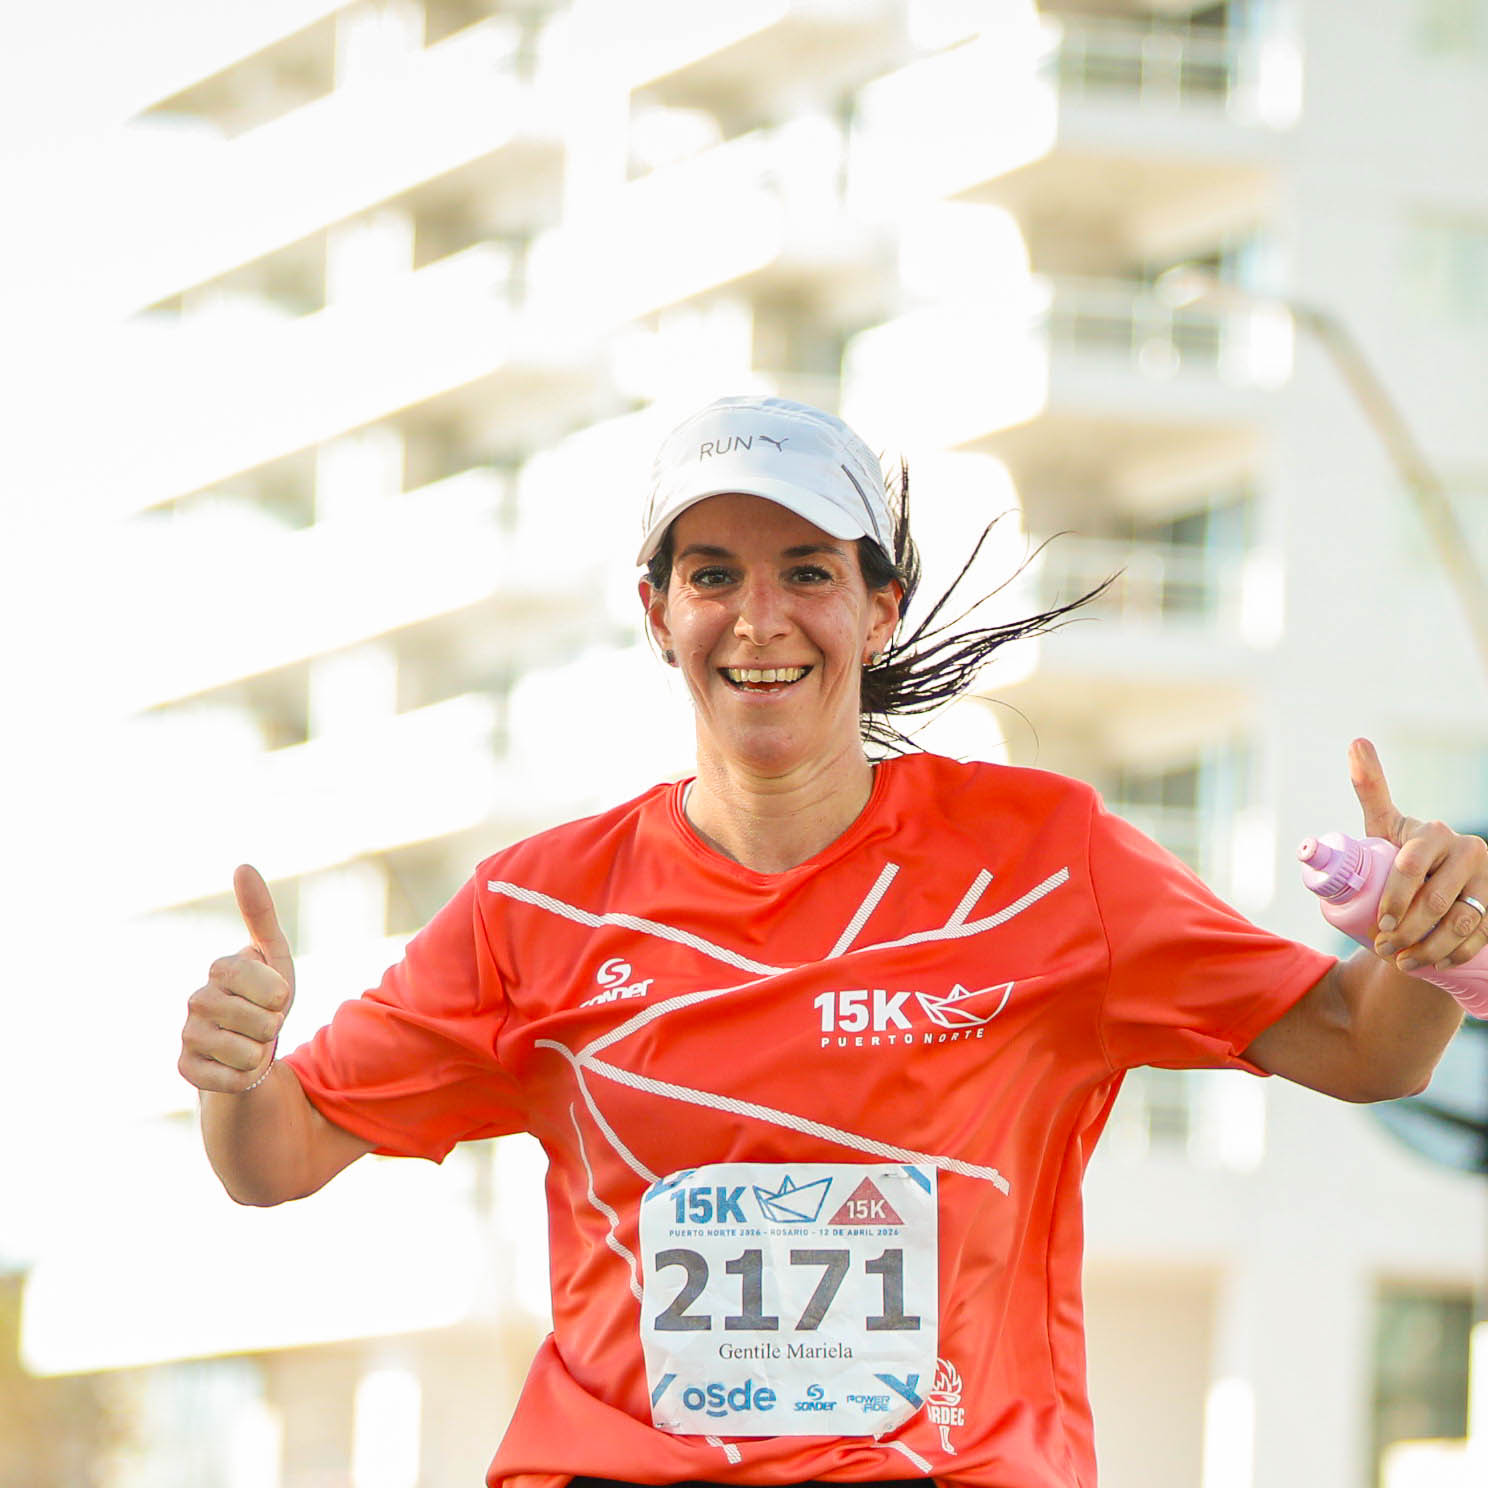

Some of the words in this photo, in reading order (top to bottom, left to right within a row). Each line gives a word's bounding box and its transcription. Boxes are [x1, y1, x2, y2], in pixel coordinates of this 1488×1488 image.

[699, 435, 753, 462] RUN
[813, 990, 913, 1033] 15K
[821, 1034, 914, 1048] PUERTO
[923, 1028, 986, 1046] NORTE
[670, 1186, 748, 1225] 15K
[846, 1200, 887, 1220] 15K
[669, 1229, 705, 1238] PUERTO
[707, 1229, 737, 1238] NORTE
[770, 1228, 810, 1237] ROSARIO
[819, 1228, 830, 1237] 12
[832, 1228, 844, 1237] DE
[847, 1228, 874, 1237] ABRIL
[654, 1248, 921, 1331] 2171
[718, 1343, 780, 1361] Gentile
[787, 1343, 853, 1360] Mariela
[682, 1378, 777, 1413] osde
[846, 1394, 891, 1404] POWER
